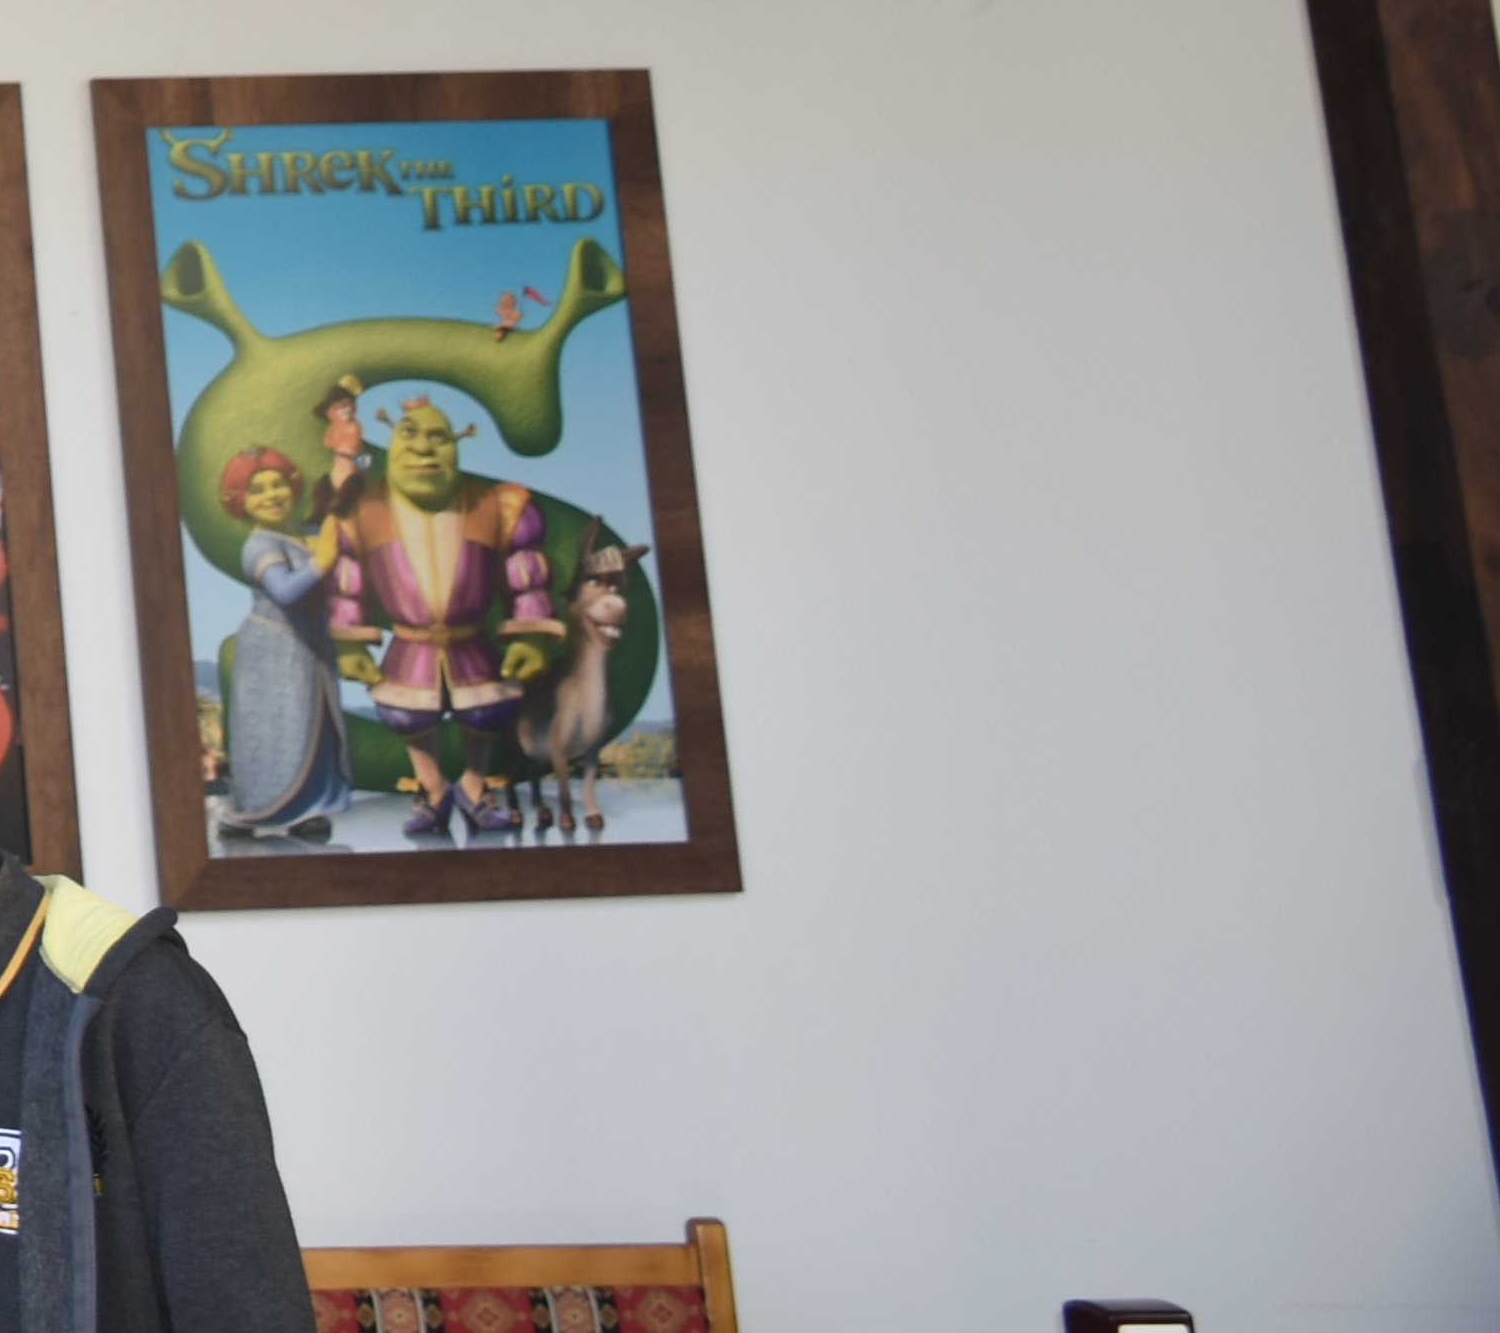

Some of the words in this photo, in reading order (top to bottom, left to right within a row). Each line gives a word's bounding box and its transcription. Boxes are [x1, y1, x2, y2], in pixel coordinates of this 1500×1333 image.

[162, 132, 404, 201] SHREK
[400, 159, 456, 181] THE
[409, 173, 606, 231] THIRD
